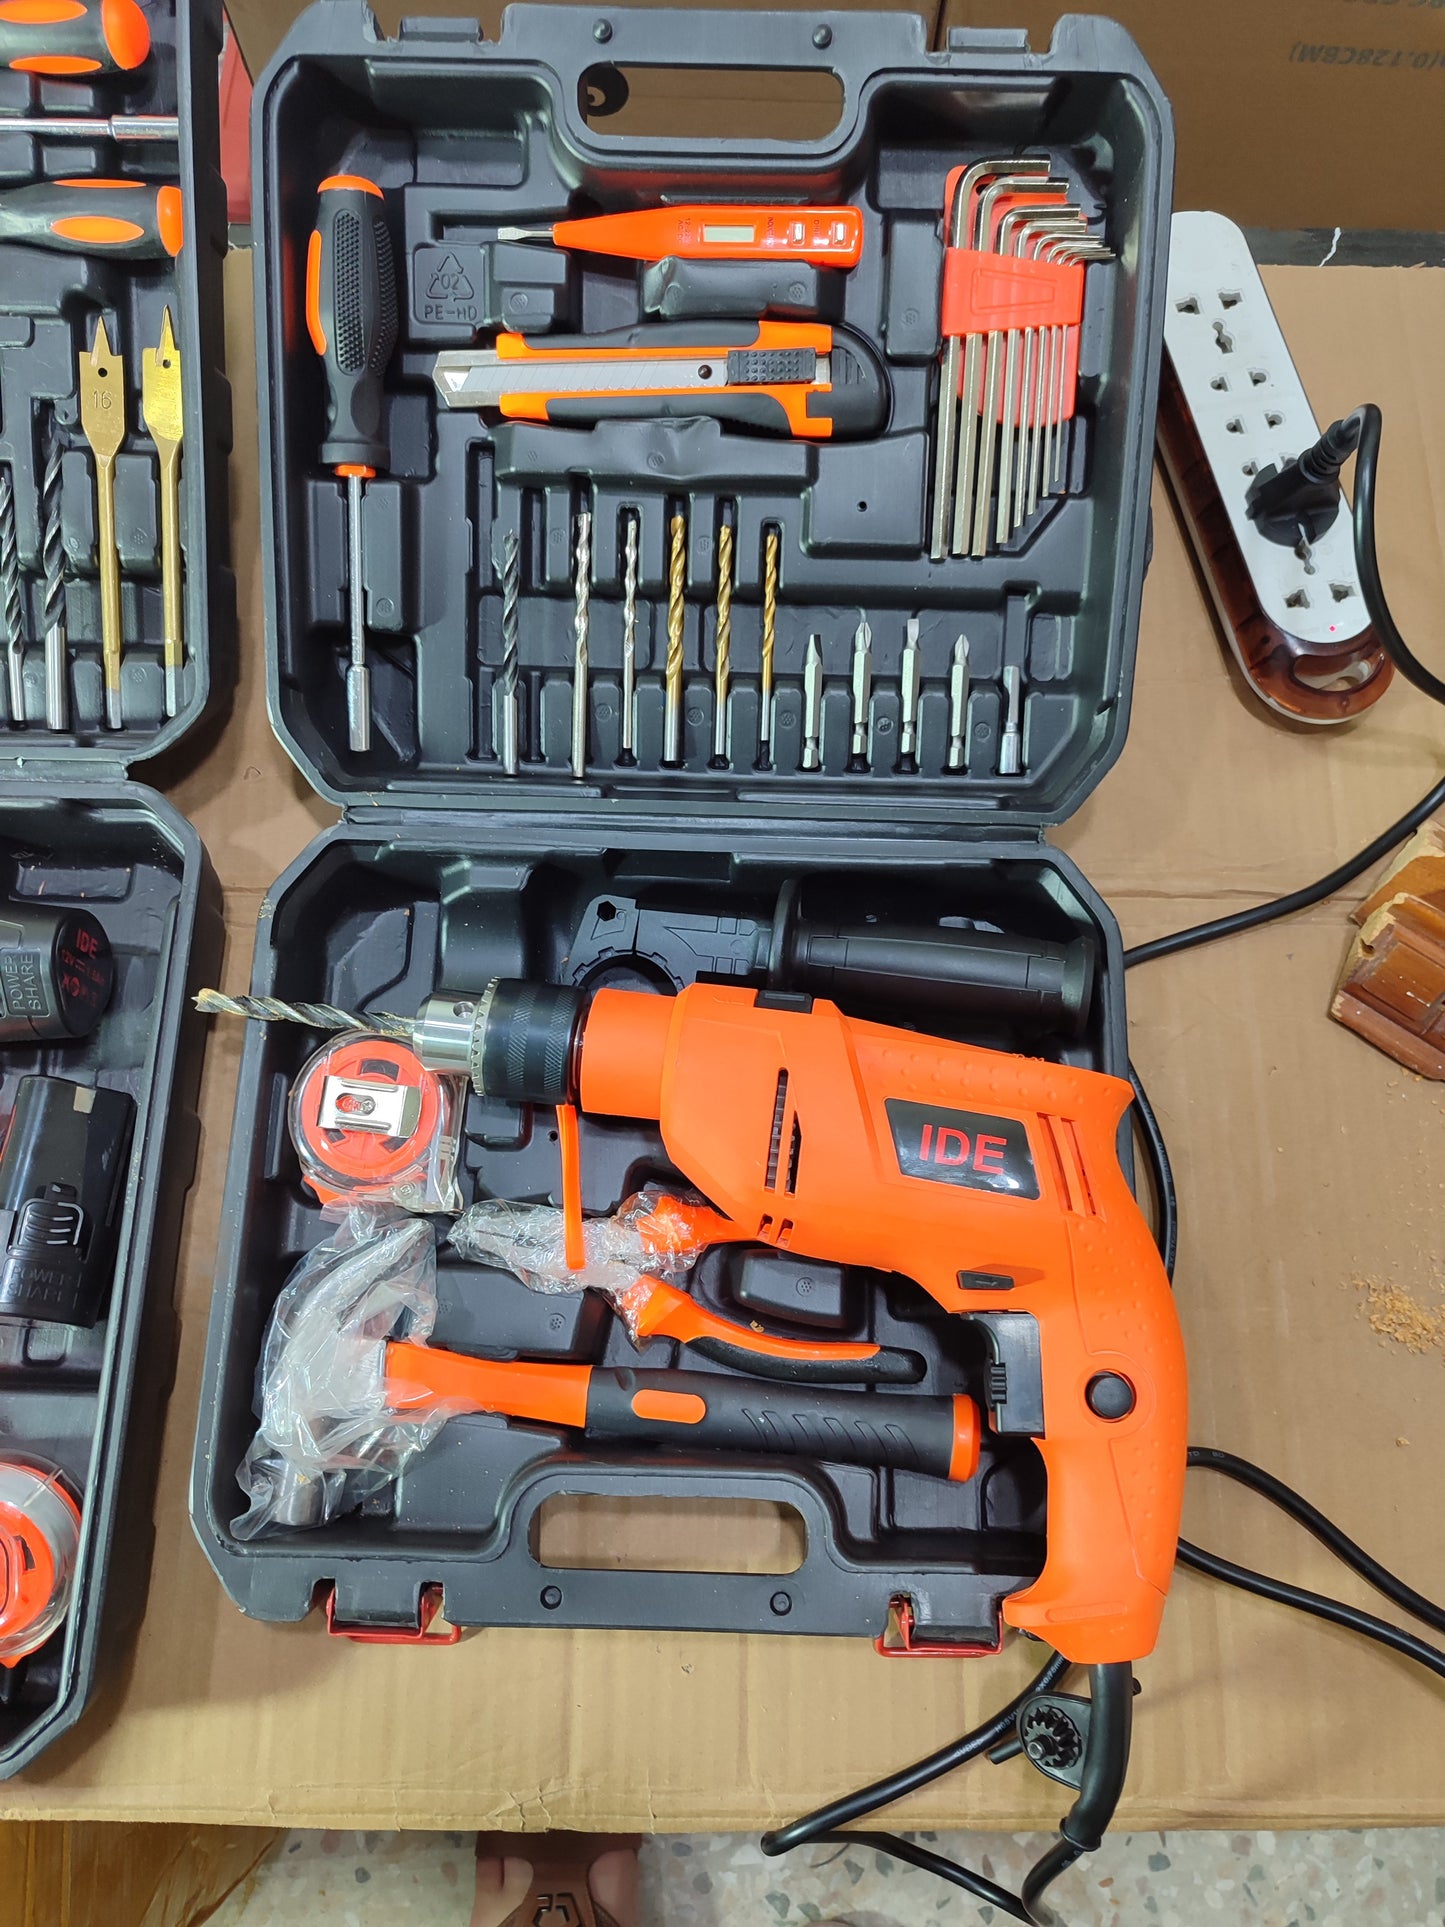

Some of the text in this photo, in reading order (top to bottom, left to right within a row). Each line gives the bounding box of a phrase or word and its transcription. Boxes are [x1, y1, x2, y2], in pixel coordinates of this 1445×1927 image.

[441, 273, 460, 290] 02
[424, 304, 478, 321] PE-HD
[93, 390, 112, 409] 16
[76, 927, 99, 960] IDE
[21, 954, 42, 1010] SHARE
[919, 1124, 1008, 1175] IDE
